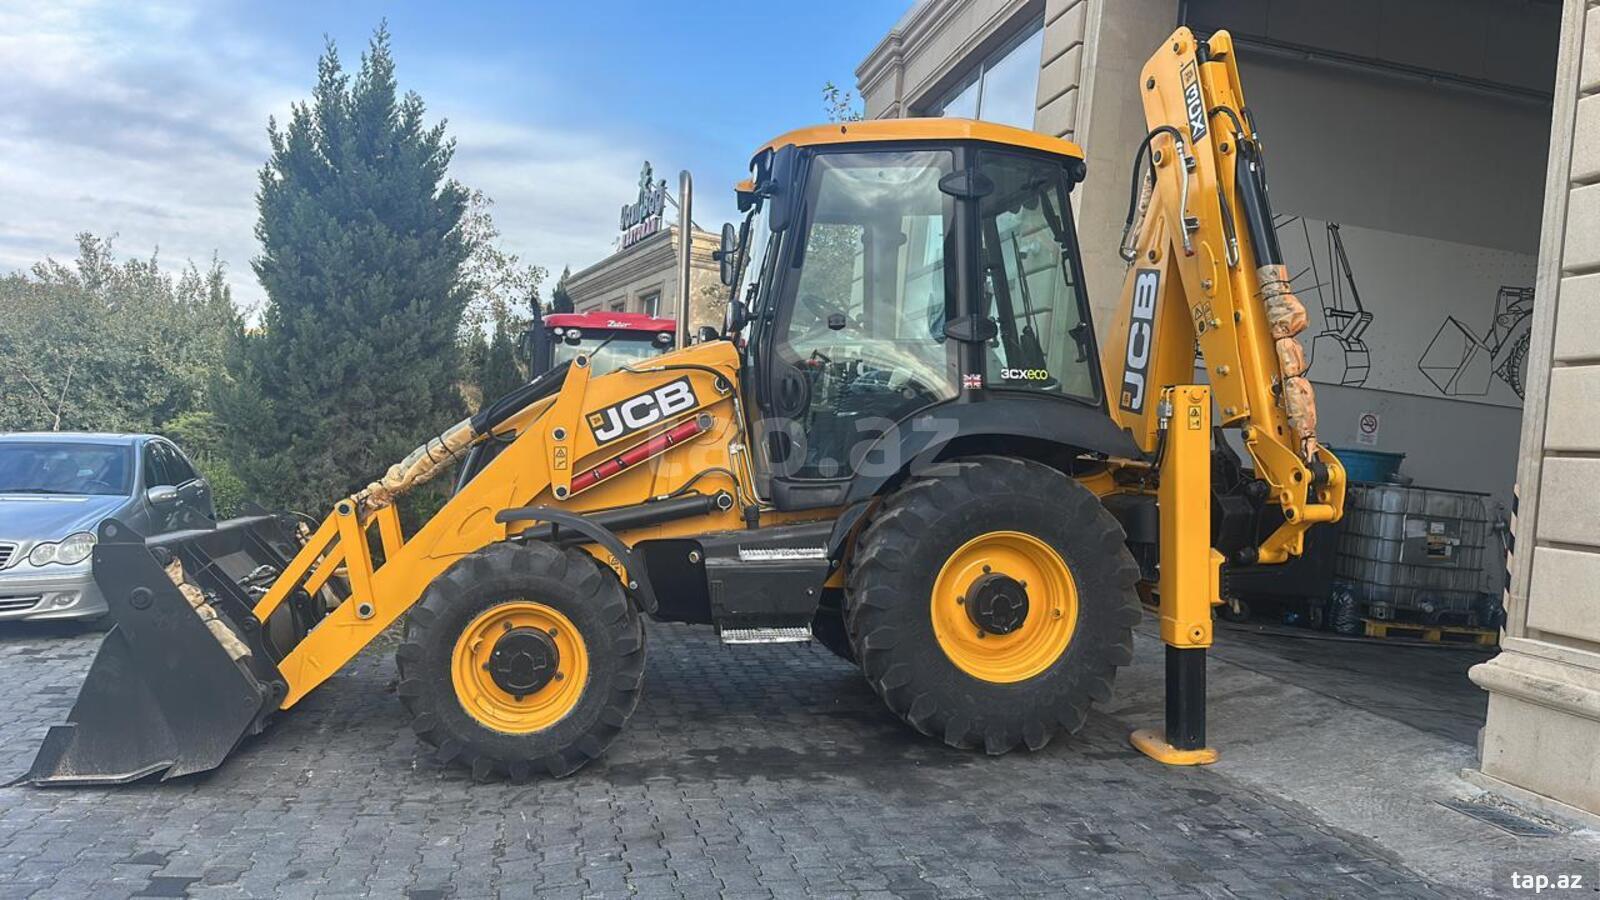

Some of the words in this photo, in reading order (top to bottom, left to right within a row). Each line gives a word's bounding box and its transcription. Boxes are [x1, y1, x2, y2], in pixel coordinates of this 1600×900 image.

[1185, 83, 1205, 137] 3CX
[1124, 272, 1157, 410] JCB
[1000, 368, 1048, 380] 3CXeco
[595, 381, 695, 441] JCB
